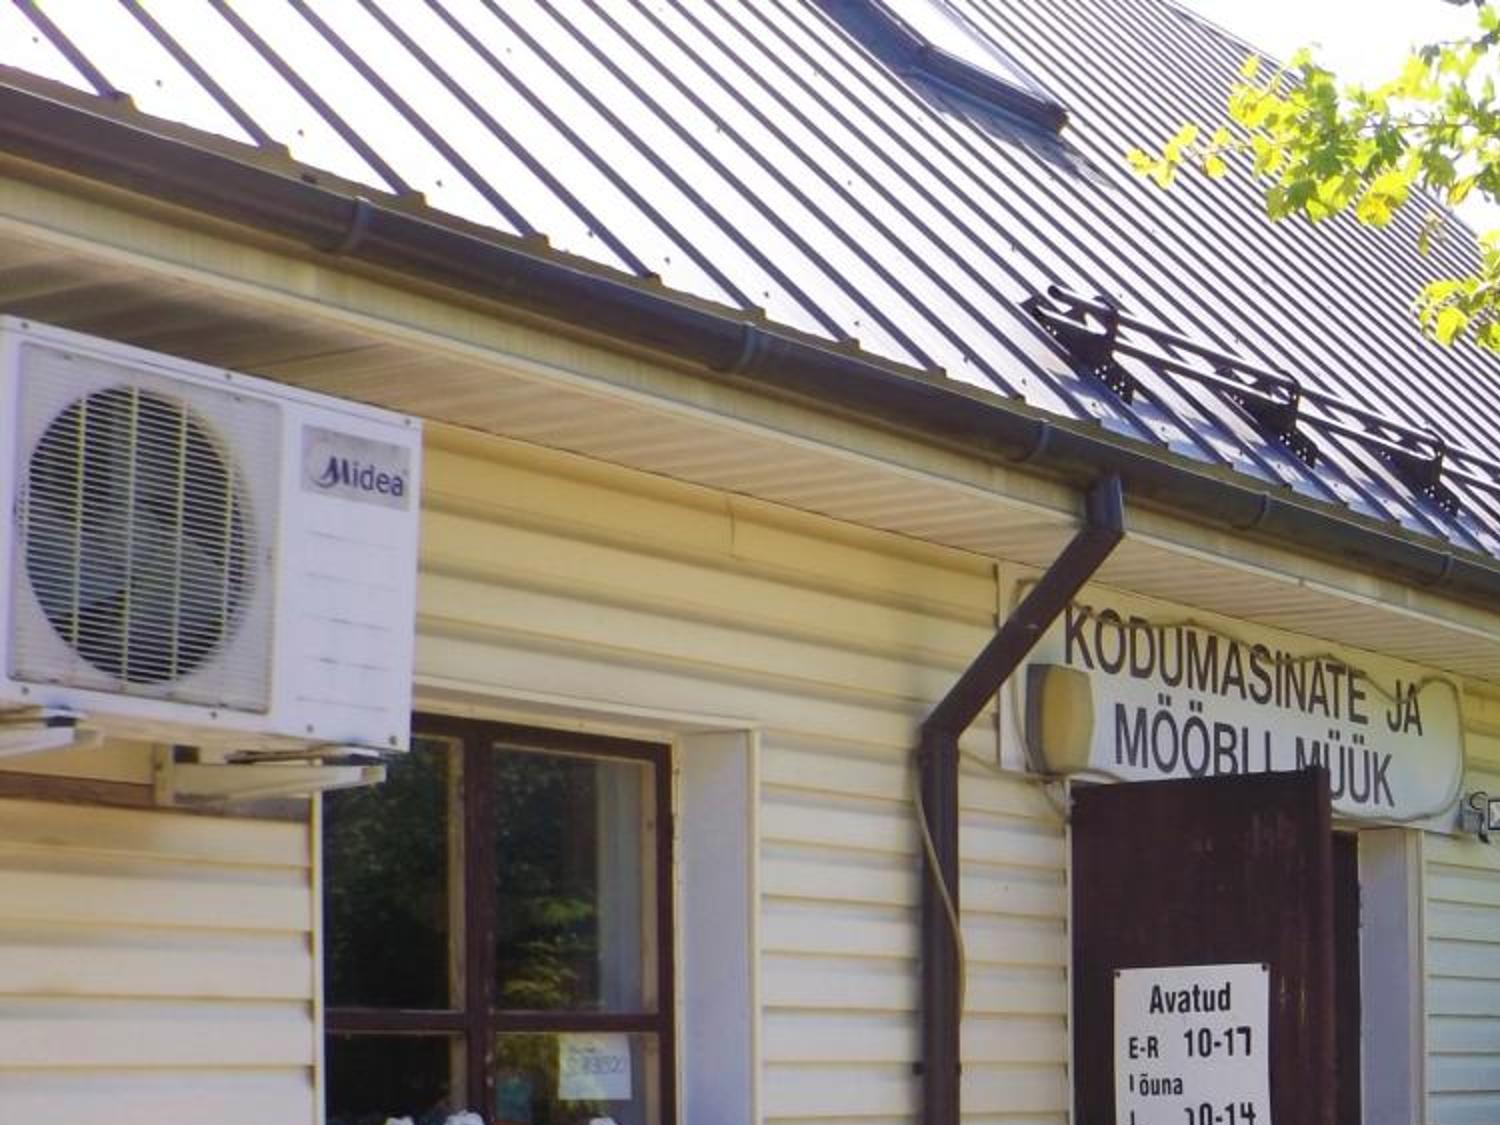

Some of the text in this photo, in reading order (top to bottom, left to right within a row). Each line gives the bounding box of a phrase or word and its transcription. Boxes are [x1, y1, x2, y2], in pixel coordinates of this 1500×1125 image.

[314, 456, 404, 497] Midea
[1064, 605, 1423, 737] KODUMASINATE JA
[1150, 982, 1231, 1014] Avatud
[1128, 1026, 1251, 1059] E-R 10-17
